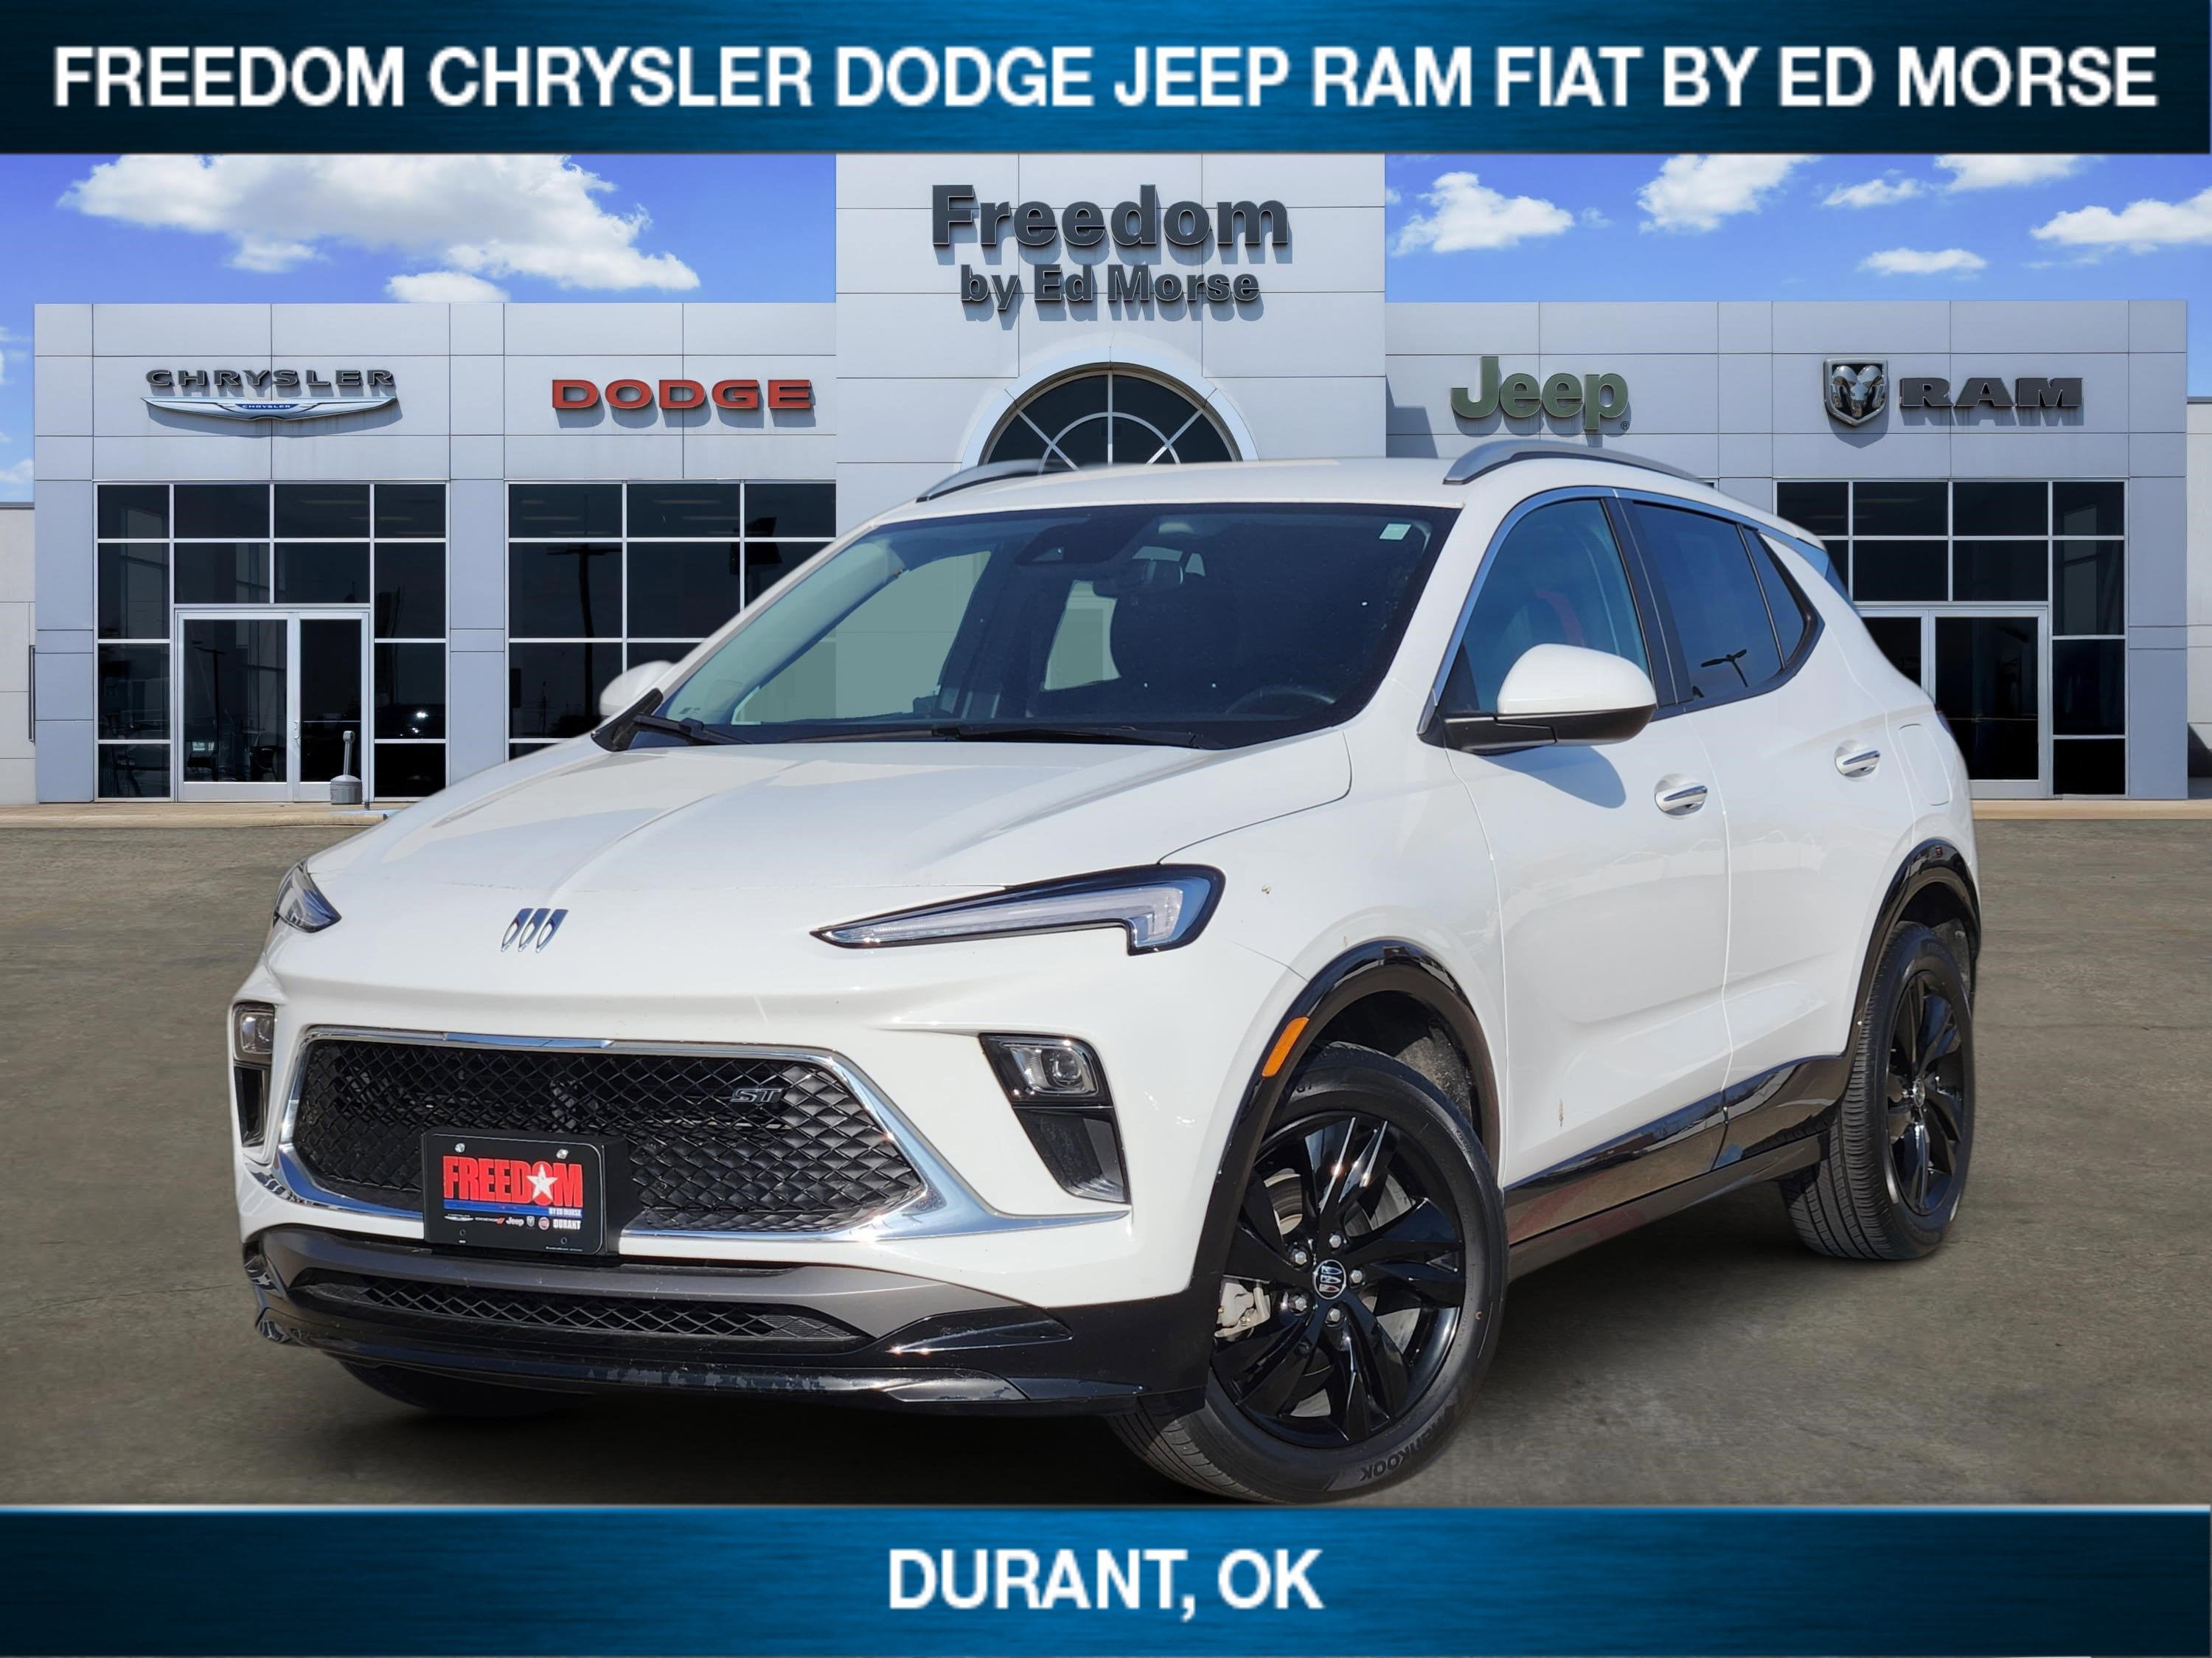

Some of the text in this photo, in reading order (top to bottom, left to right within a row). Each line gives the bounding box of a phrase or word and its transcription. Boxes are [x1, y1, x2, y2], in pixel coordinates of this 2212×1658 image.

[932, 184, 1290, 246] Freedom
[961, 264, 1260, 311] by Ed Morse
[146, 370, 394, 386] CHRYSLER
[1450, 356, 1629, 430] Jeep
[1899, 377, 2083, 407] RAM
[552, 379, 811, 409] DODGE
[730, 1088, 783, 1103] ST
[442, 1156, 583, 1208] FREEDOM
[505, 1216, 524, 1227] Jeep
[552, 1218, 581, 1230] DURANT
